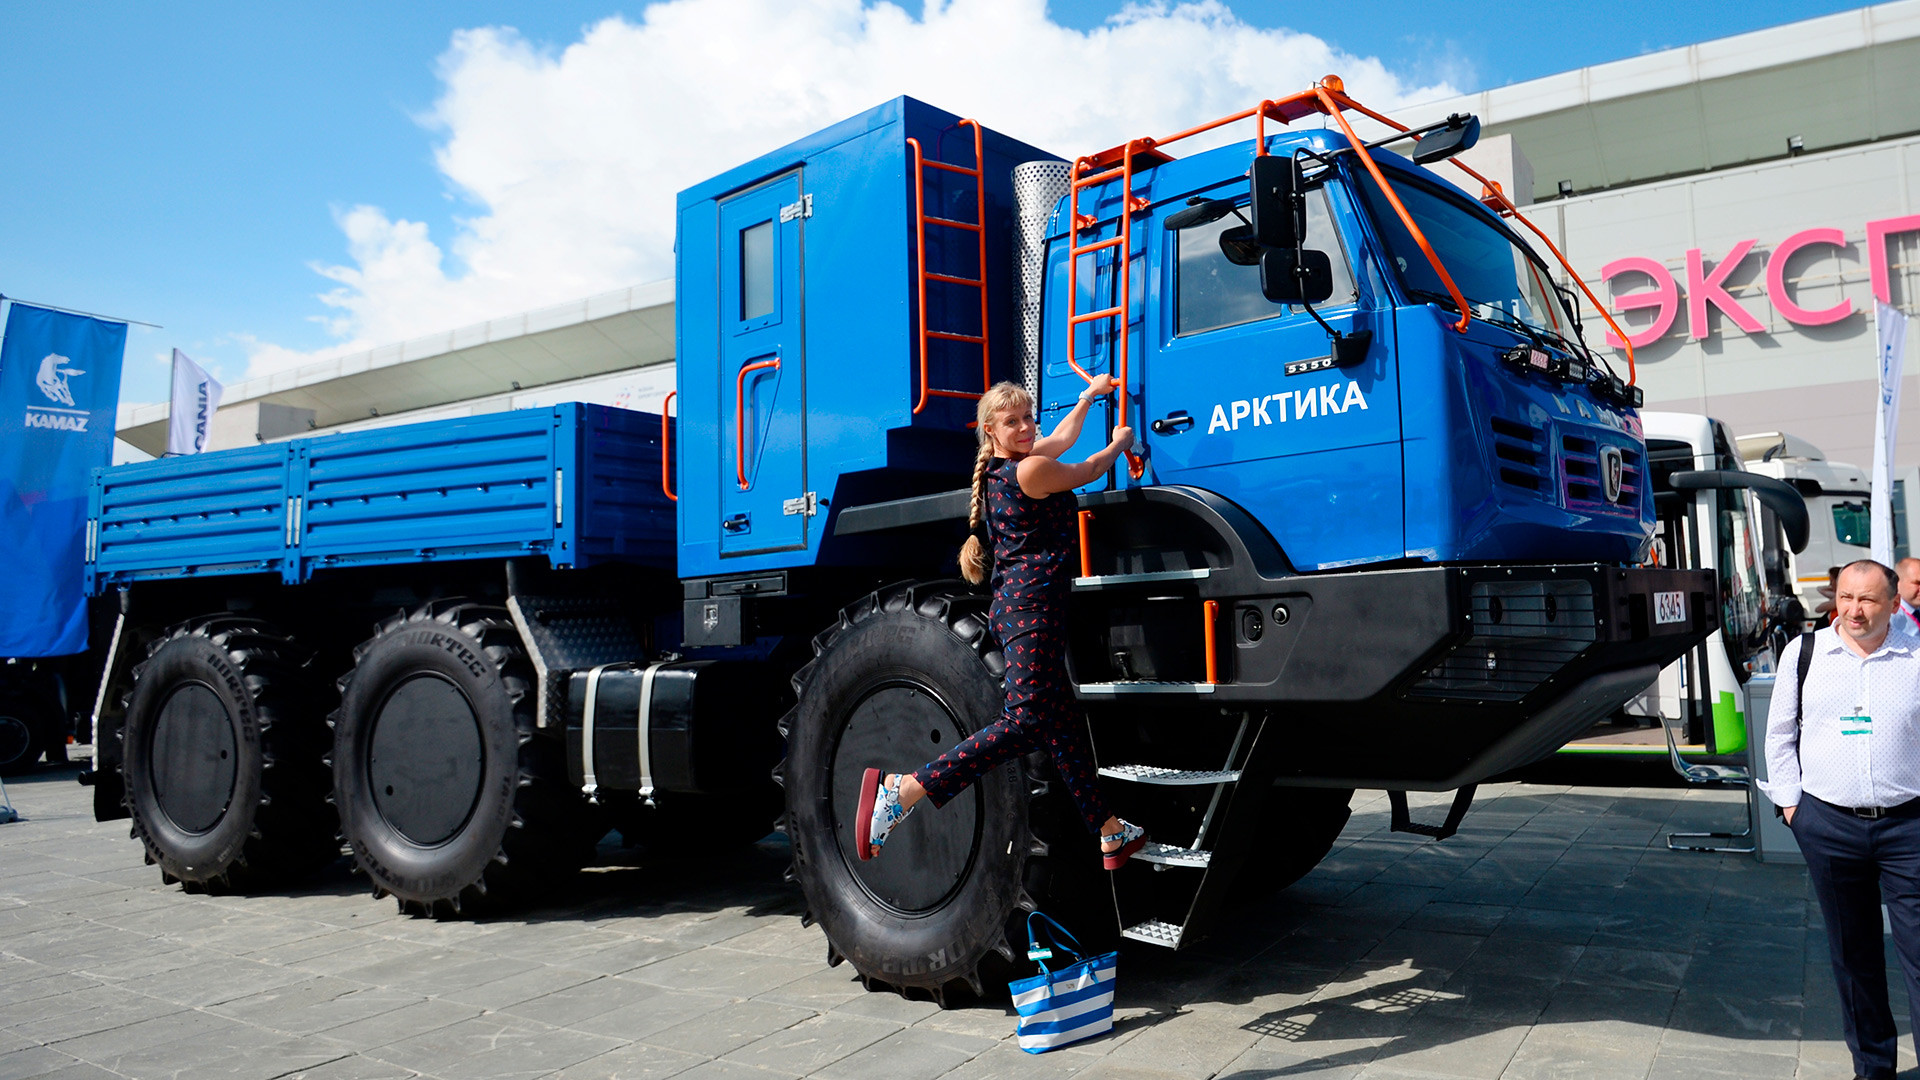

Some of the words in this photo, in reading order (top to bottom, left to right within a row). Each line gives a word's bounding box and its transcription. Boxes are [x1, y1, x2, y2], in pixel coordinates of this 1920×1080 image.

[1287, 357, 1333, 374] 5350
[194, 380, 207, 451] CANIA
[1207, 380, 1369, 435] АРКТИКА
[24, 412, 89, 432] KAMAZ
[1659, 593, 1682, 621] 6345
